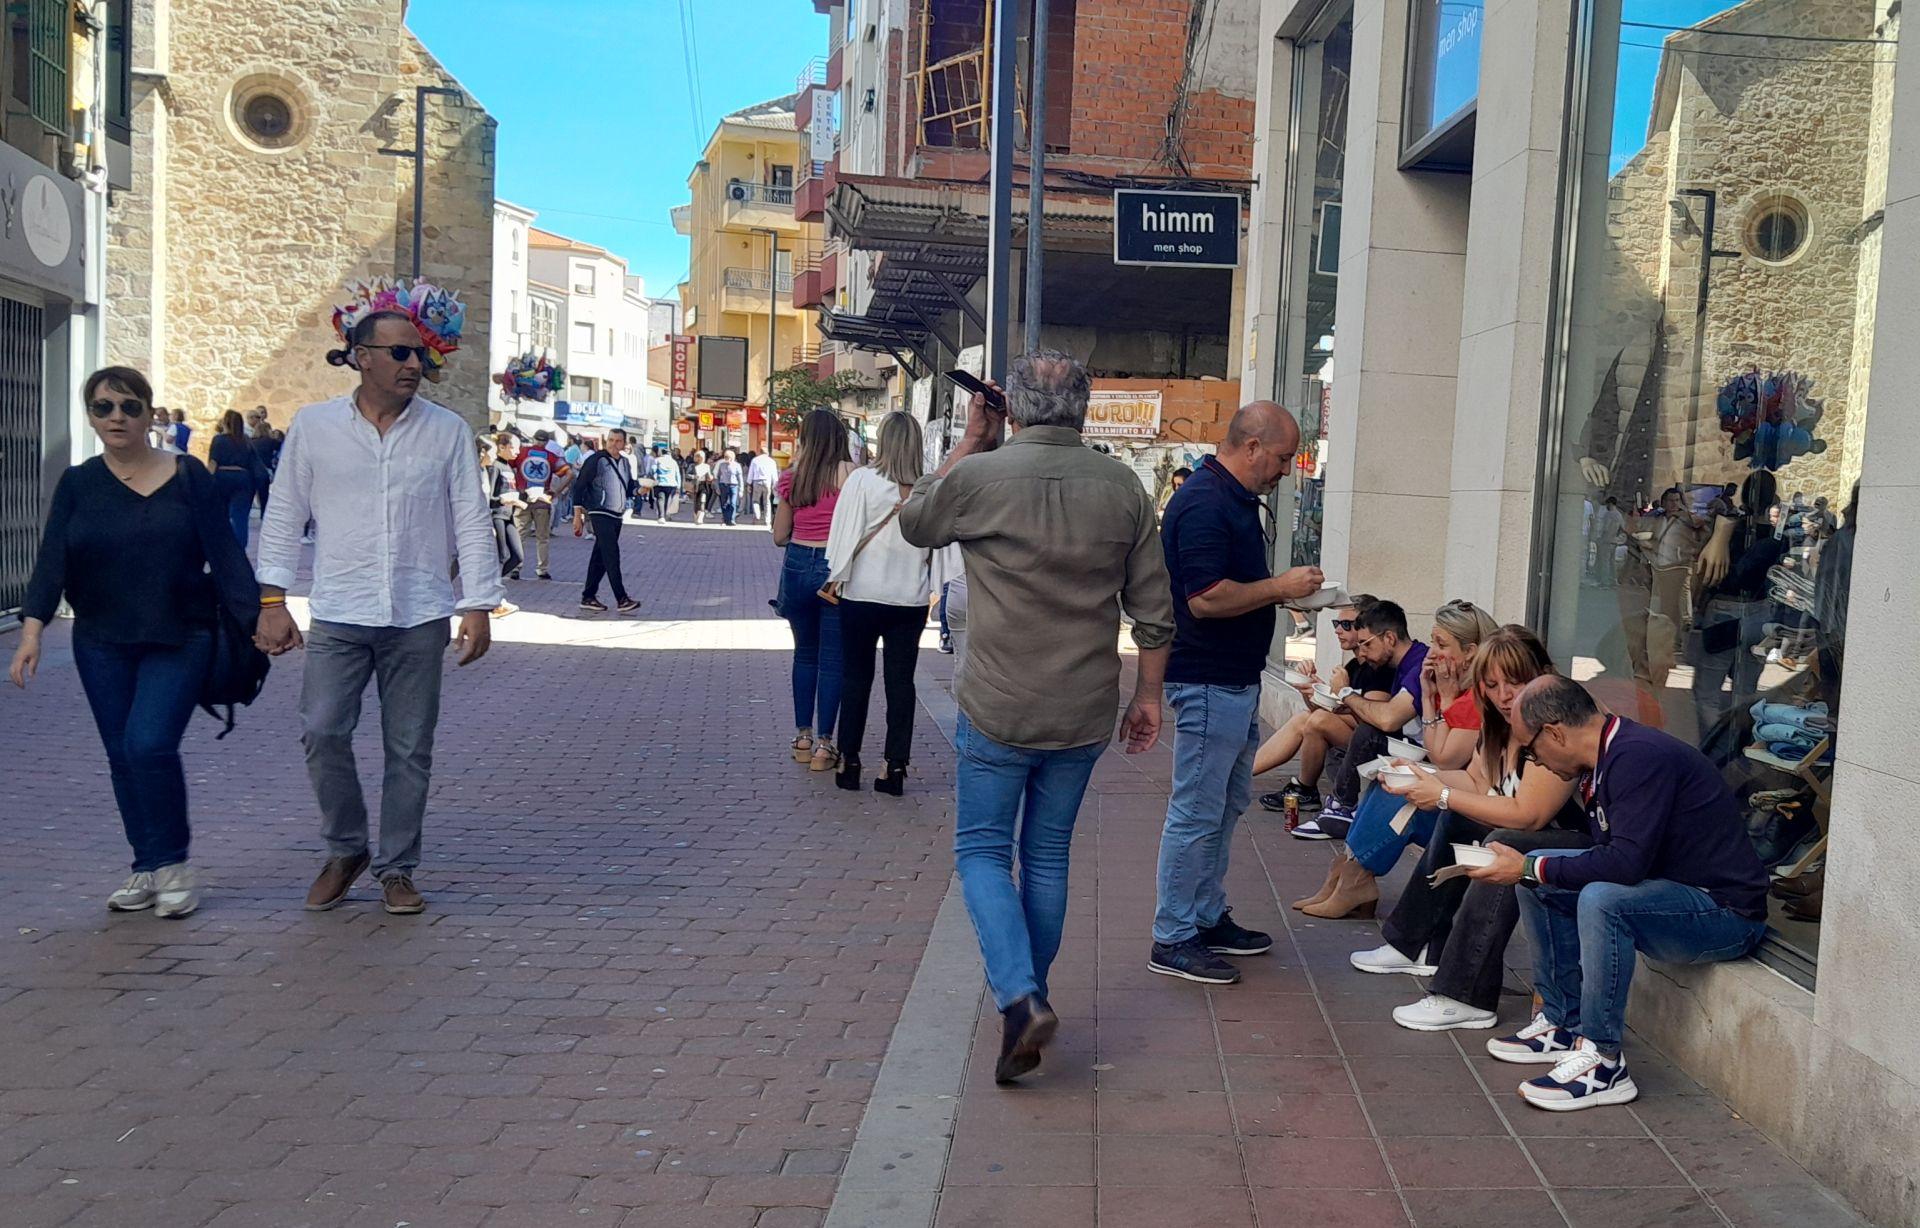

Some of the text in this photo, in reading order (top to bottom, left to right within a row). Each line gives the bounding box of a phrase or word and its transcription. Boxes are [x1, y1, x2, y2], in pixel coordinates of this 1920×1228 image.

[1439, 6, 1478, 57] men shop
[1142, 202, 1214, 233] himm
[1153, 243, 1203, 255] men shop
[675, 343, 686, 390] ROCHA
[570, 402, 603, 416] ROCHA
